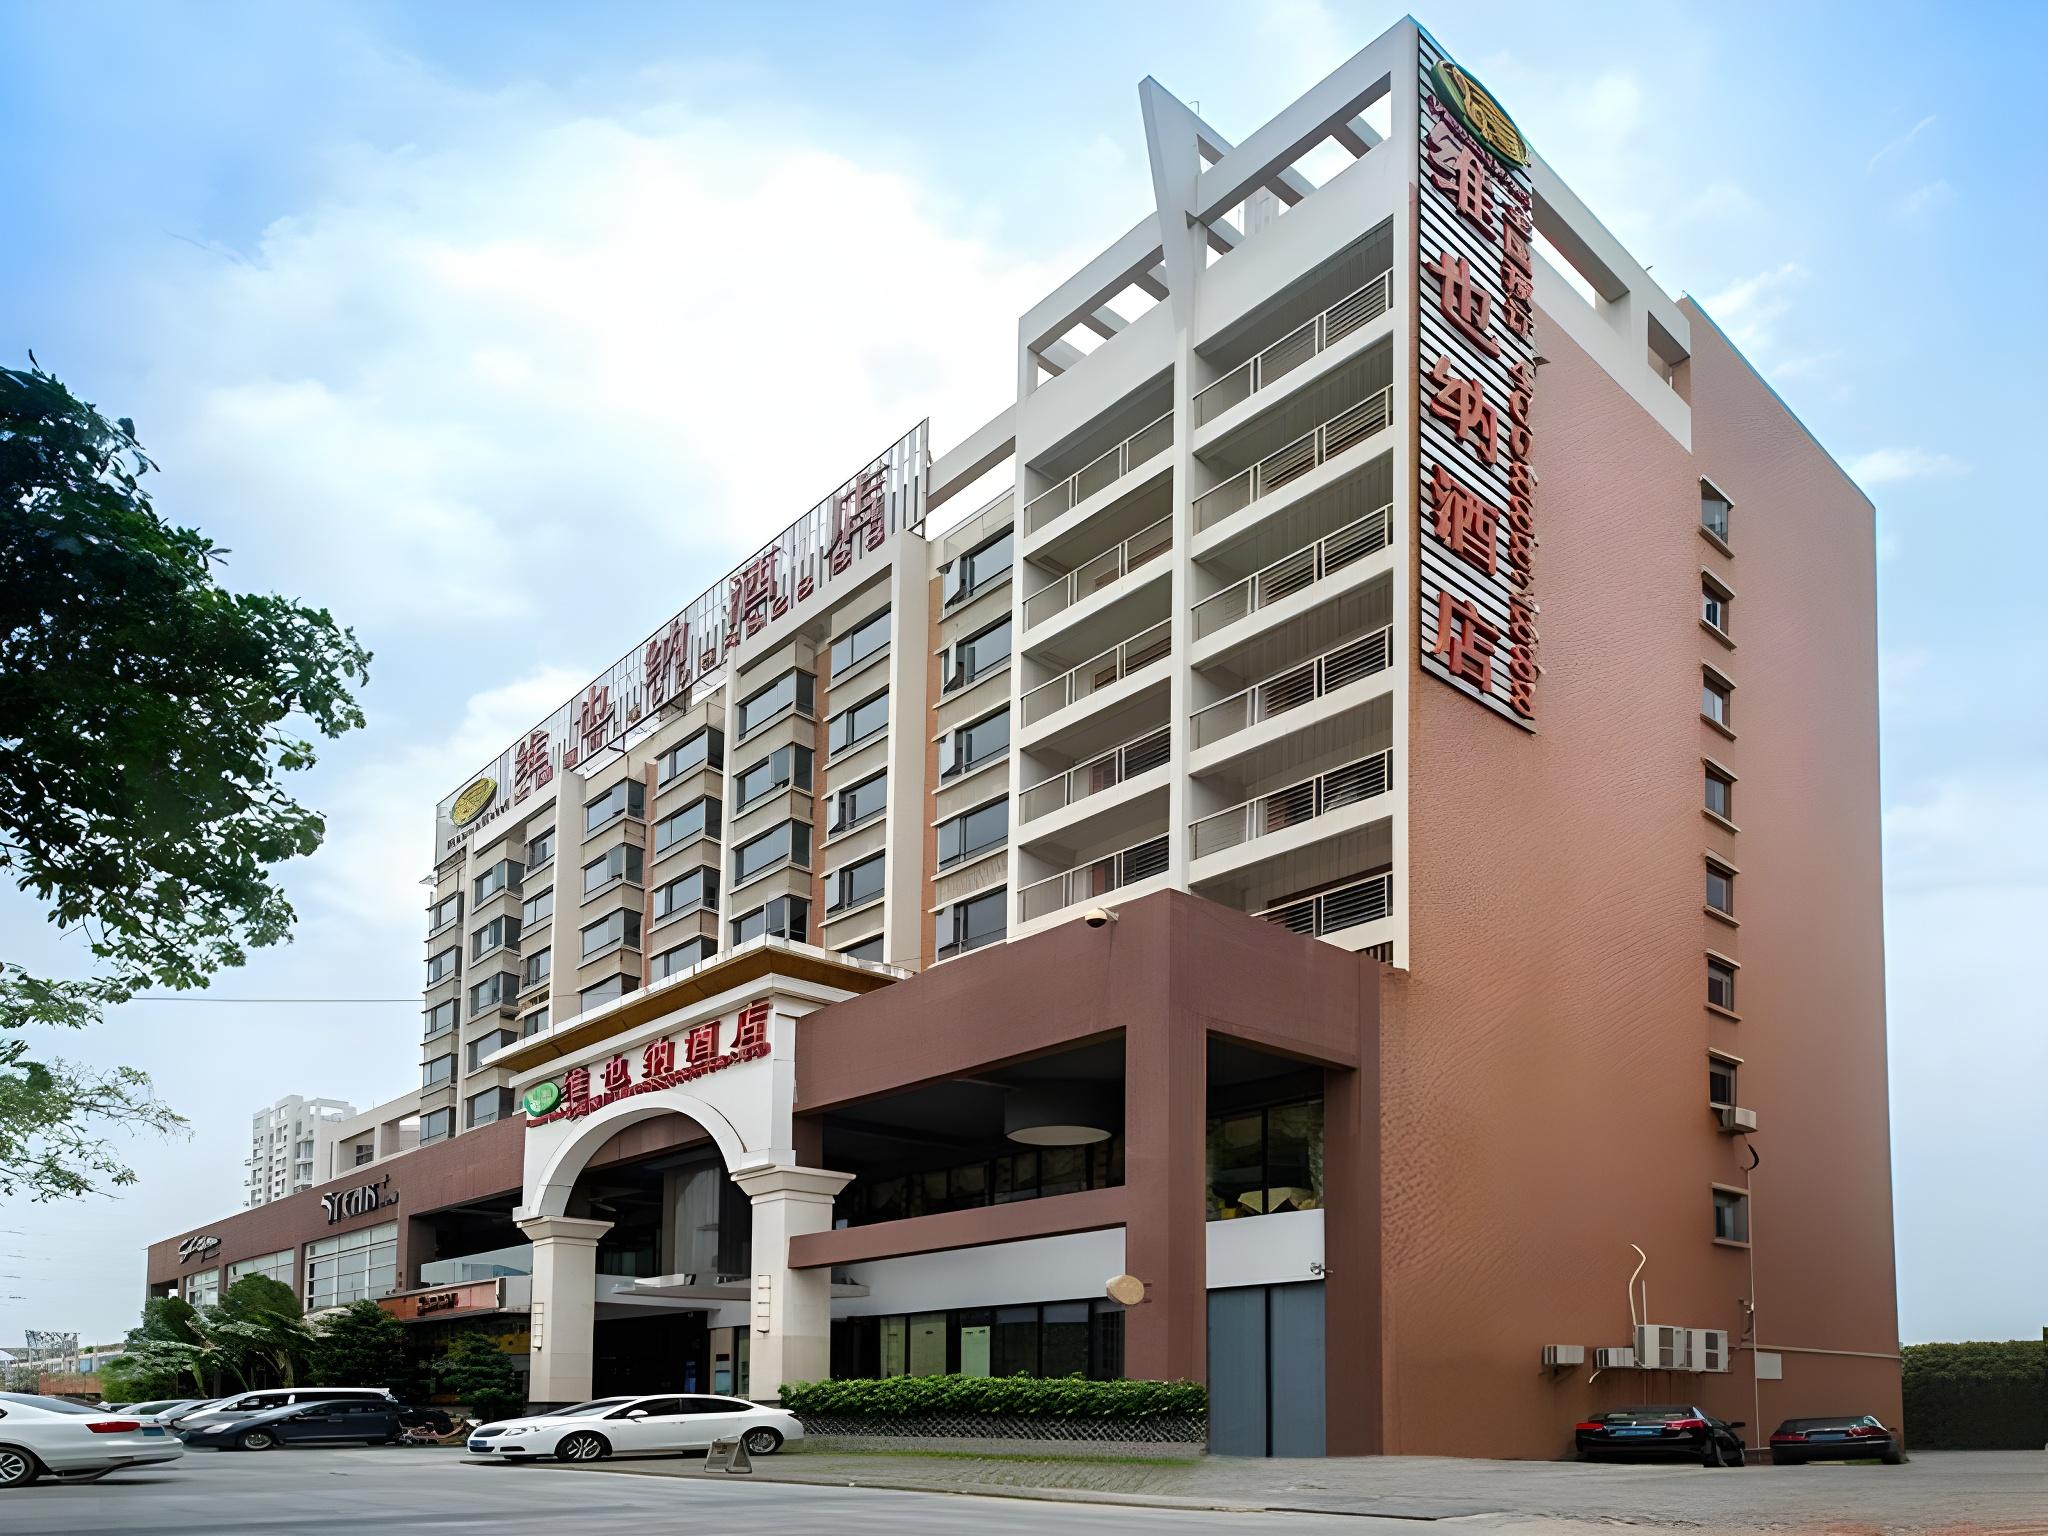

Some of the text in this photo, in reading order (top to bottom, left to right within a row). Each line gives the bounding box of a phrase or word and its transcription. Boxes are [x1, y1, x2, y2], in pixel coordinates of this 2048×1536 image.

[1422, 121, 1501, 693] 维也纳酒店
